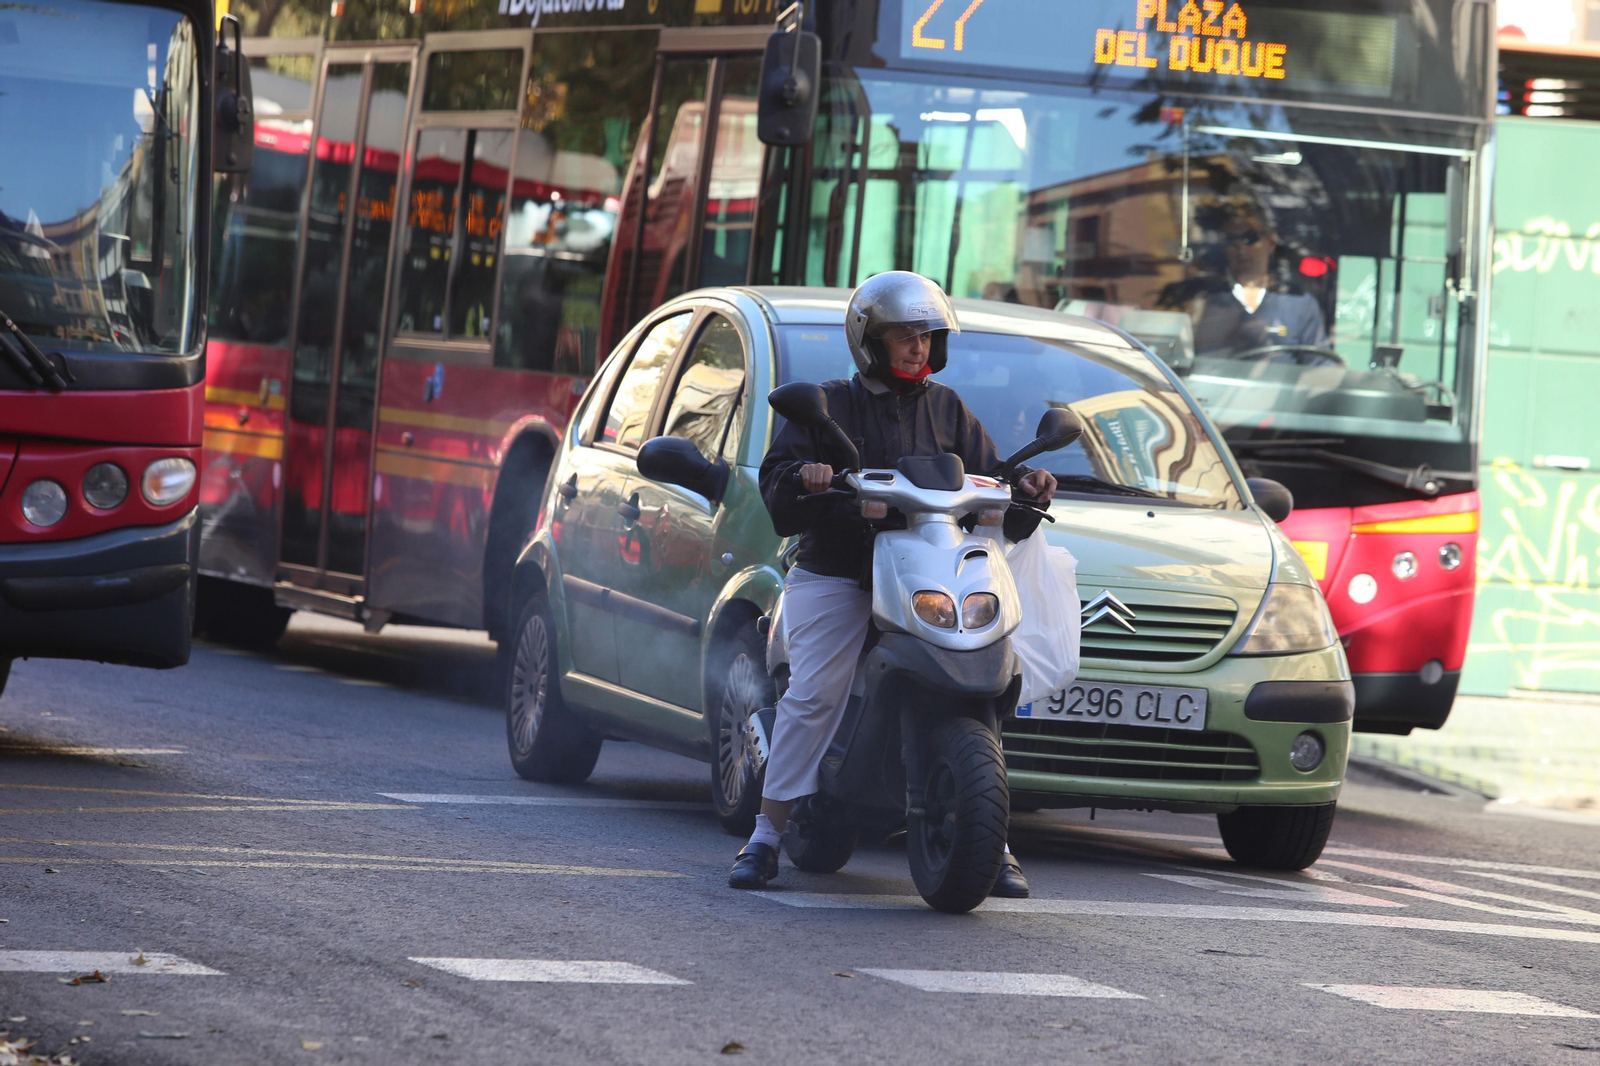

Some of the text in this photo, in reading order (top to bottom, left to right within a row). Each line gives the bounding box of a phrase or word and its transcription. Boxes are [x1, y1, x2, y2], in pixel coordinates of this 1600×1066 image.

[1136, 0, 1247, 38] PLAZA
[1094, 28, 1287, 79] DEL DUQUE
[1047, 686, 1194, 723] 9296 CLC
